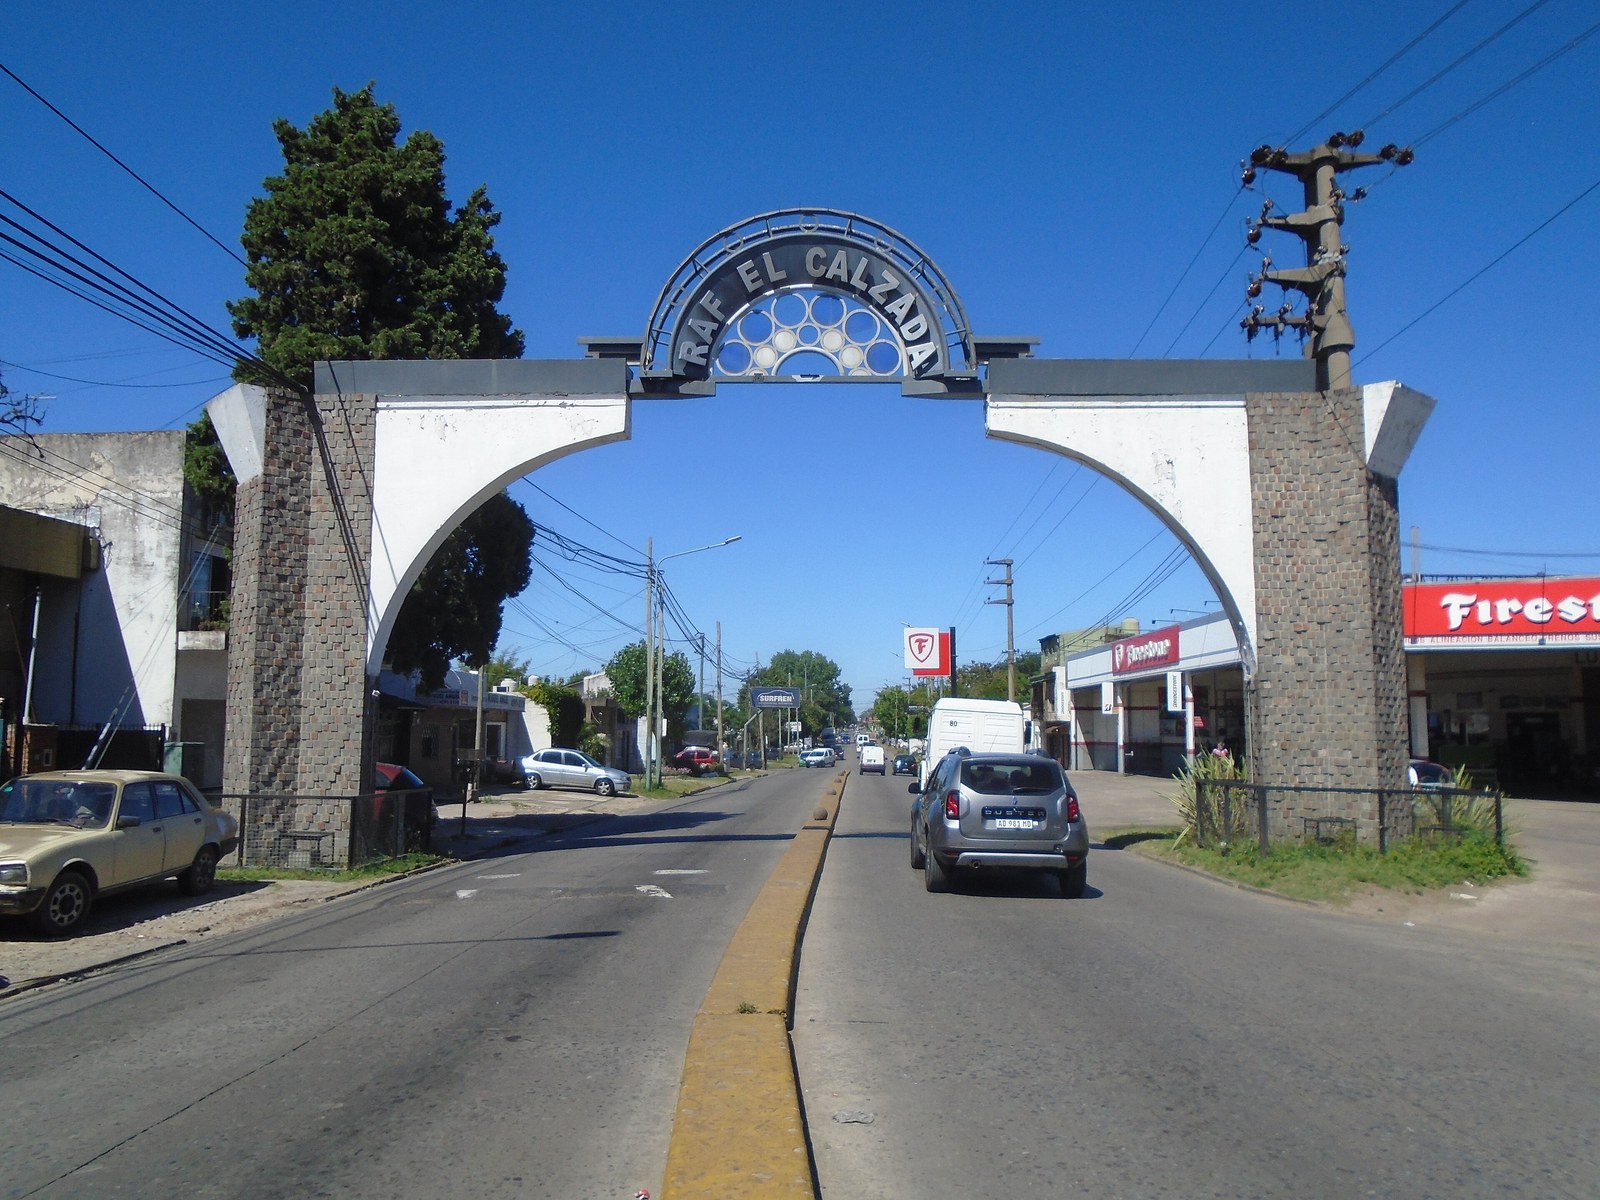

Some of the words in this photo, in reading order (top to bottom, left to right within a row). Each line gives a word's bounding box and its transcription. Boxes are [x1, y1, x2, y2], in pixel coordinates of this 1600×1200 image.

[678, 290, 726, 367] RAF
[736, 252, 787, 293] EL
[805, 247, 941, 376] CALZADA
